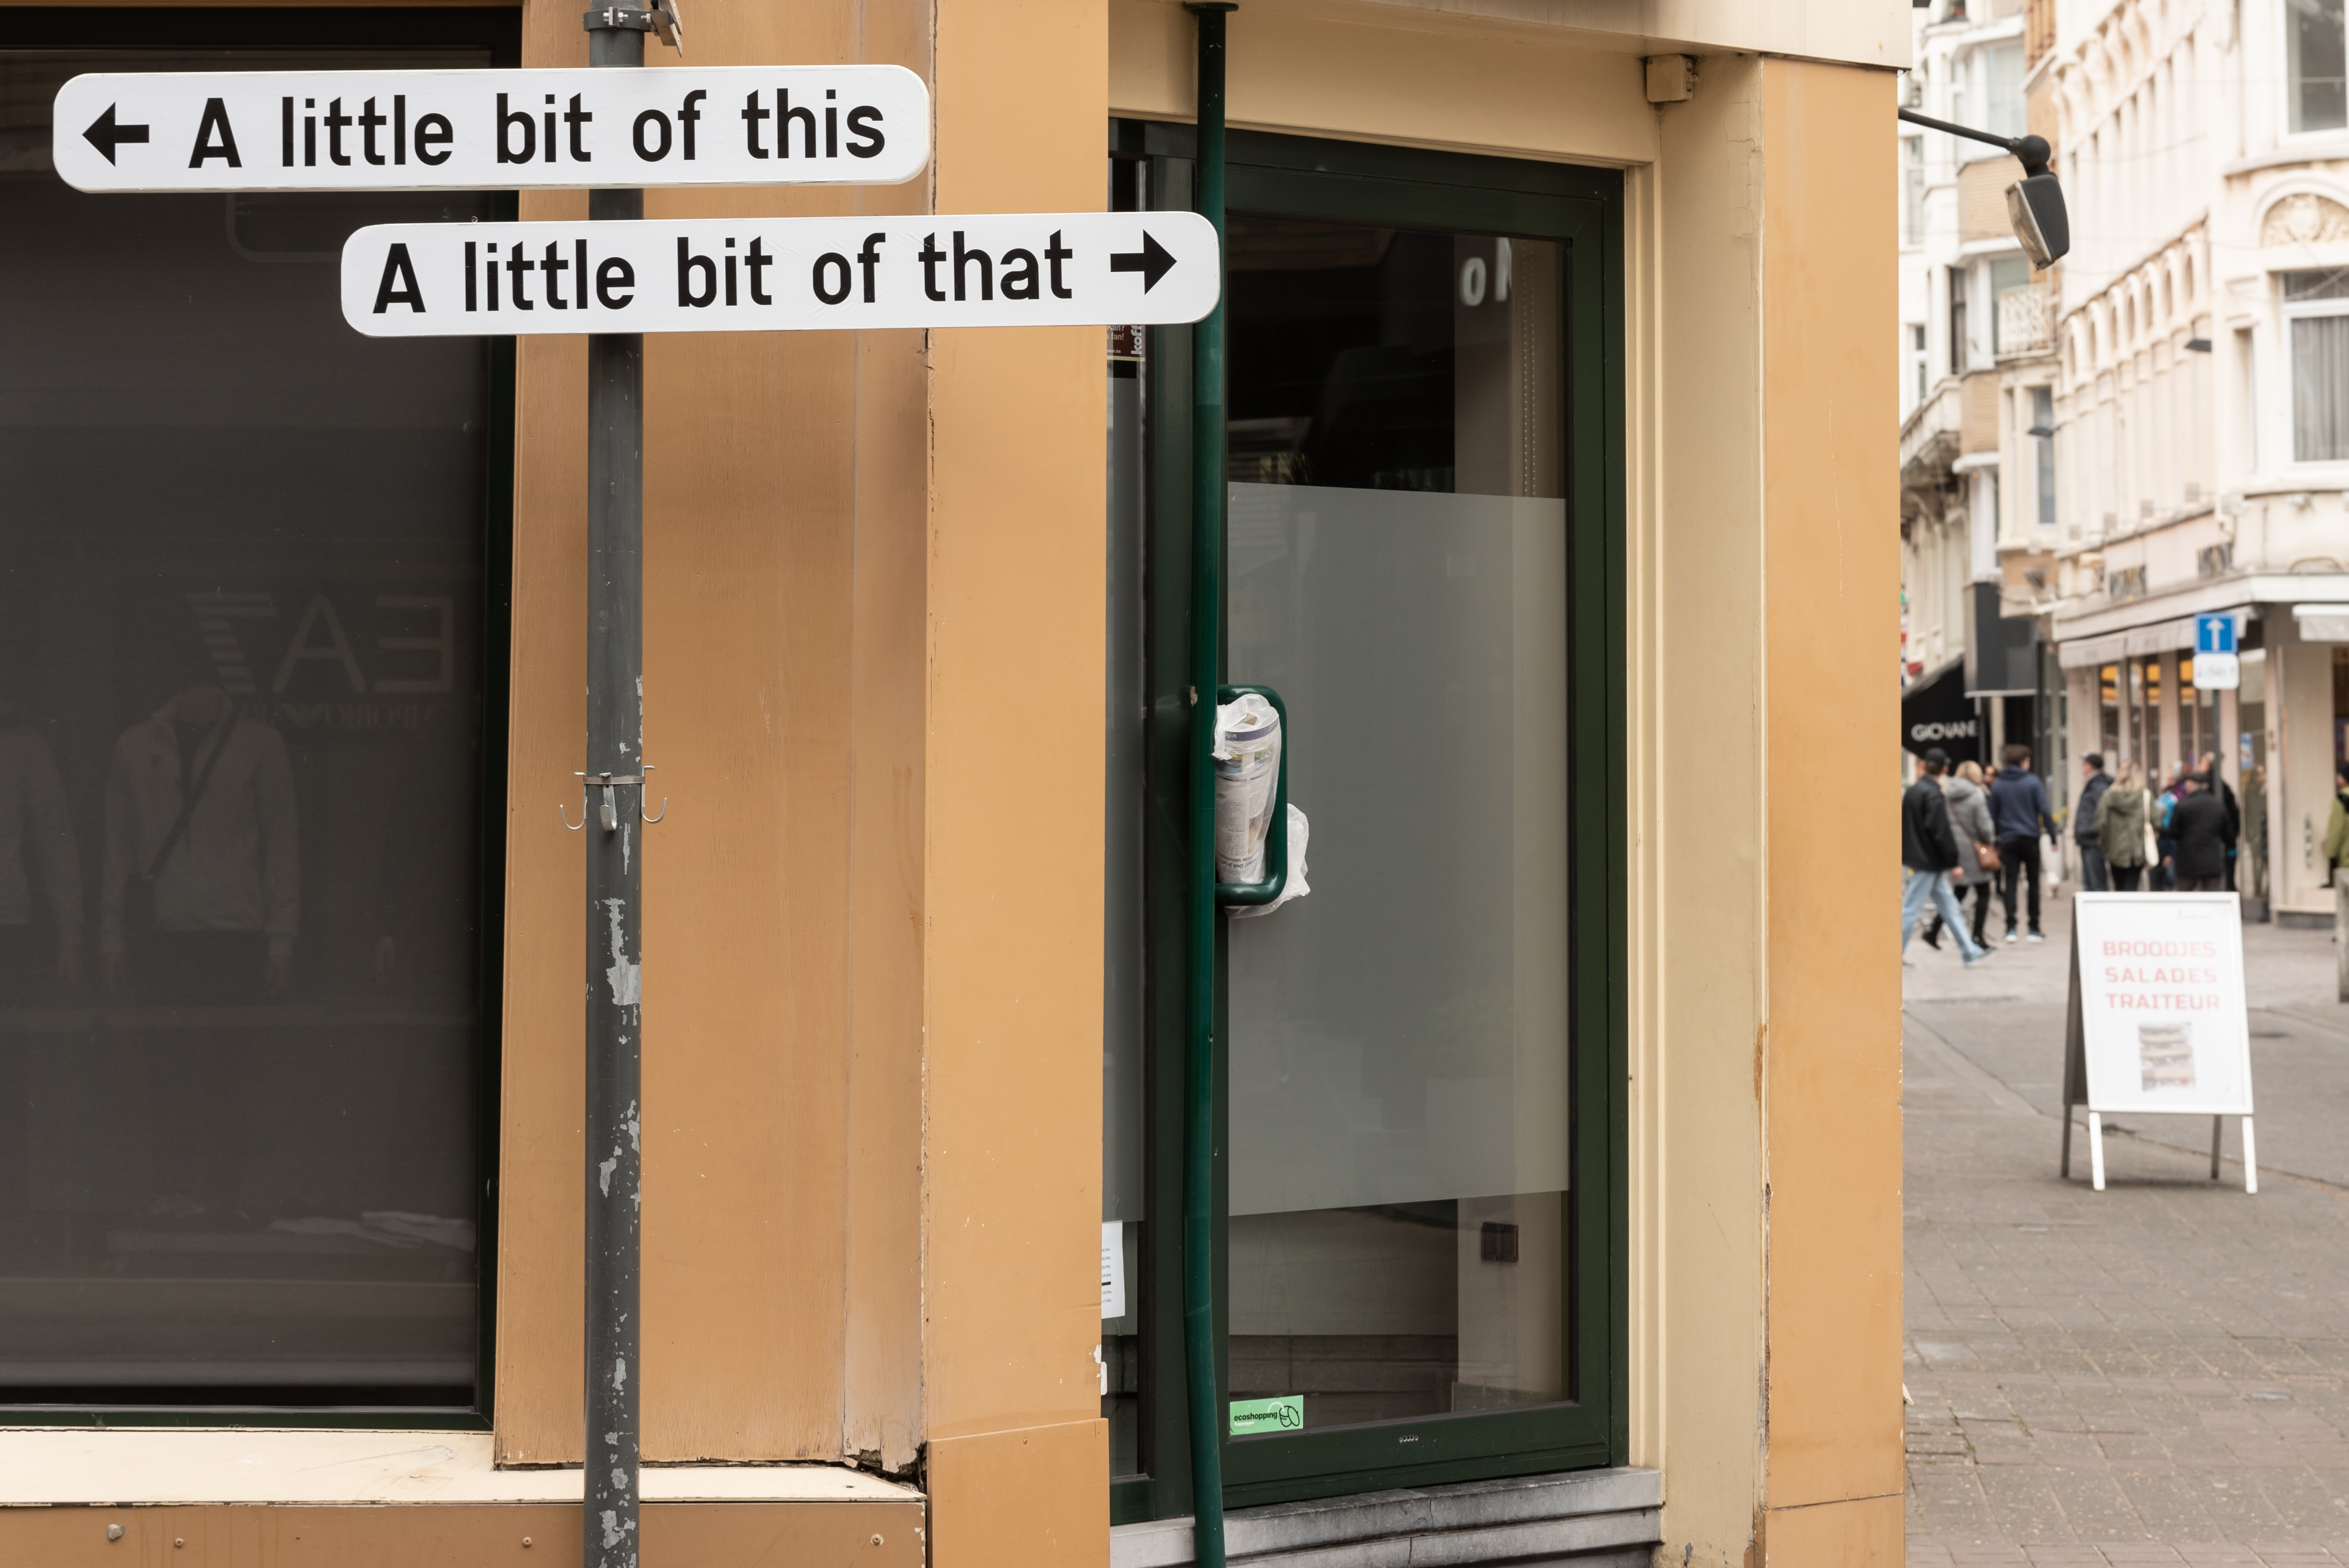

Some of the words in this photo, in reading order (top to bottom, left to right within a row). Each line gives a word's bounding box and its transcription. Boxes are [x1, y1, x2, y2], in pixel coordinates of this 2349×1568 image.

[189, 98, 242, 168] A
[283, 95, 453, 167] little
[497, 93, 592, 164] bit
[633, 90, 706, 162] of
[742, 89, 885, 159] this
[373, 243, 426, 313] A
[465, 239, 634, 311] little
[678, 236, 772, 307] bit
[813, 233, 885, 305] of
[919, 230, 1072, 301] that
[1111, 332, 1124, 341] fan!
[2103, 941, 2216, 957] BROODJES
[2105, 967, 2217, 984] SALADES
[2106, 993, 2220, 1010] TRAITEUR
[1234, 1412, 1278, 1421] ecoshopping
